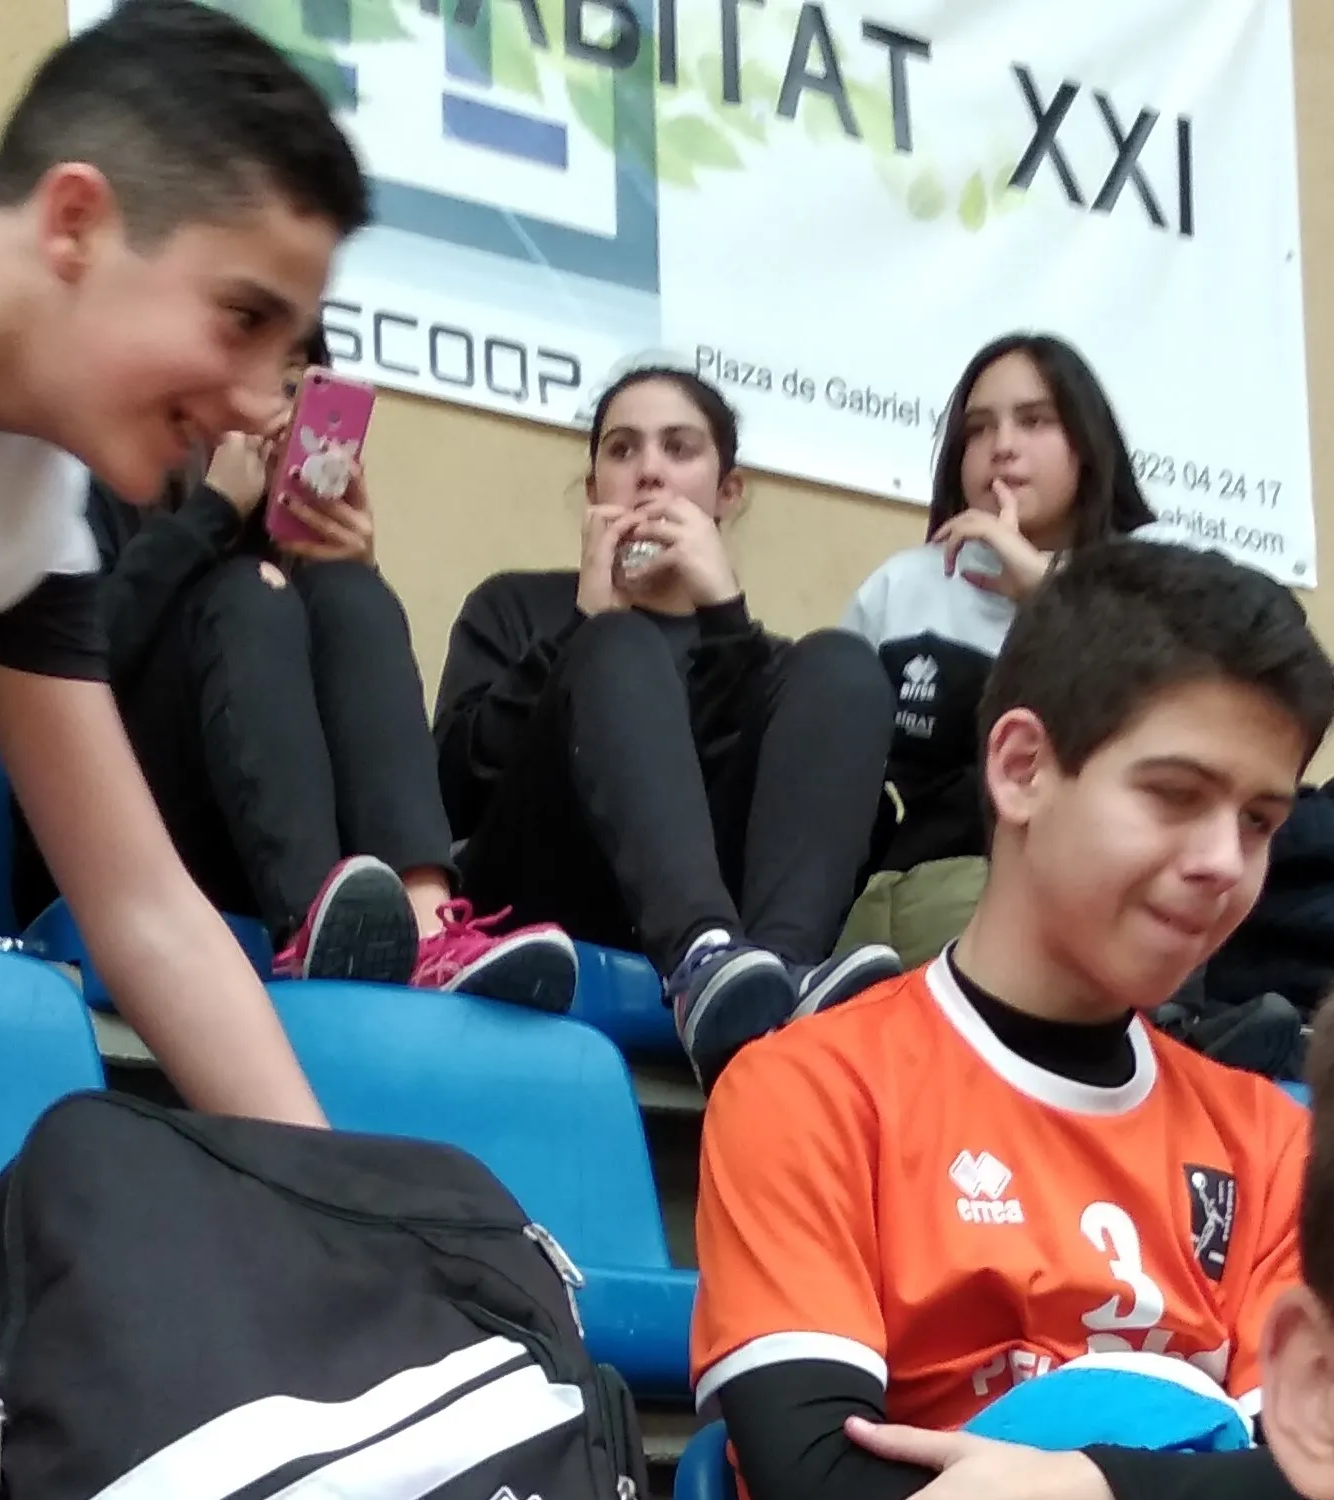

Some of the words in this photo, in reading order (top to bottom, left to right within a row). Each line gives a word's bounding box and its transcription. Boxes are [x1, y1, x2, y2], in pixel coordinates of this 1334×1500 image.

[417, 0, 932, 152] BITAT
[1008, 62, 1193, 238] XXI
[695, 343, 774, 393] Plaza
[781, 367, 816, 404] de
[825, 375, 921, 430] Gabriel
[1182, 460, 1212, 494] 04
[1218, 466, 1249, 503] 24
[1255, 478, 1283, 509] 17
[956, 1198, 1025, 1225] errea
[1080, 1201, 1164, 1331] 3
